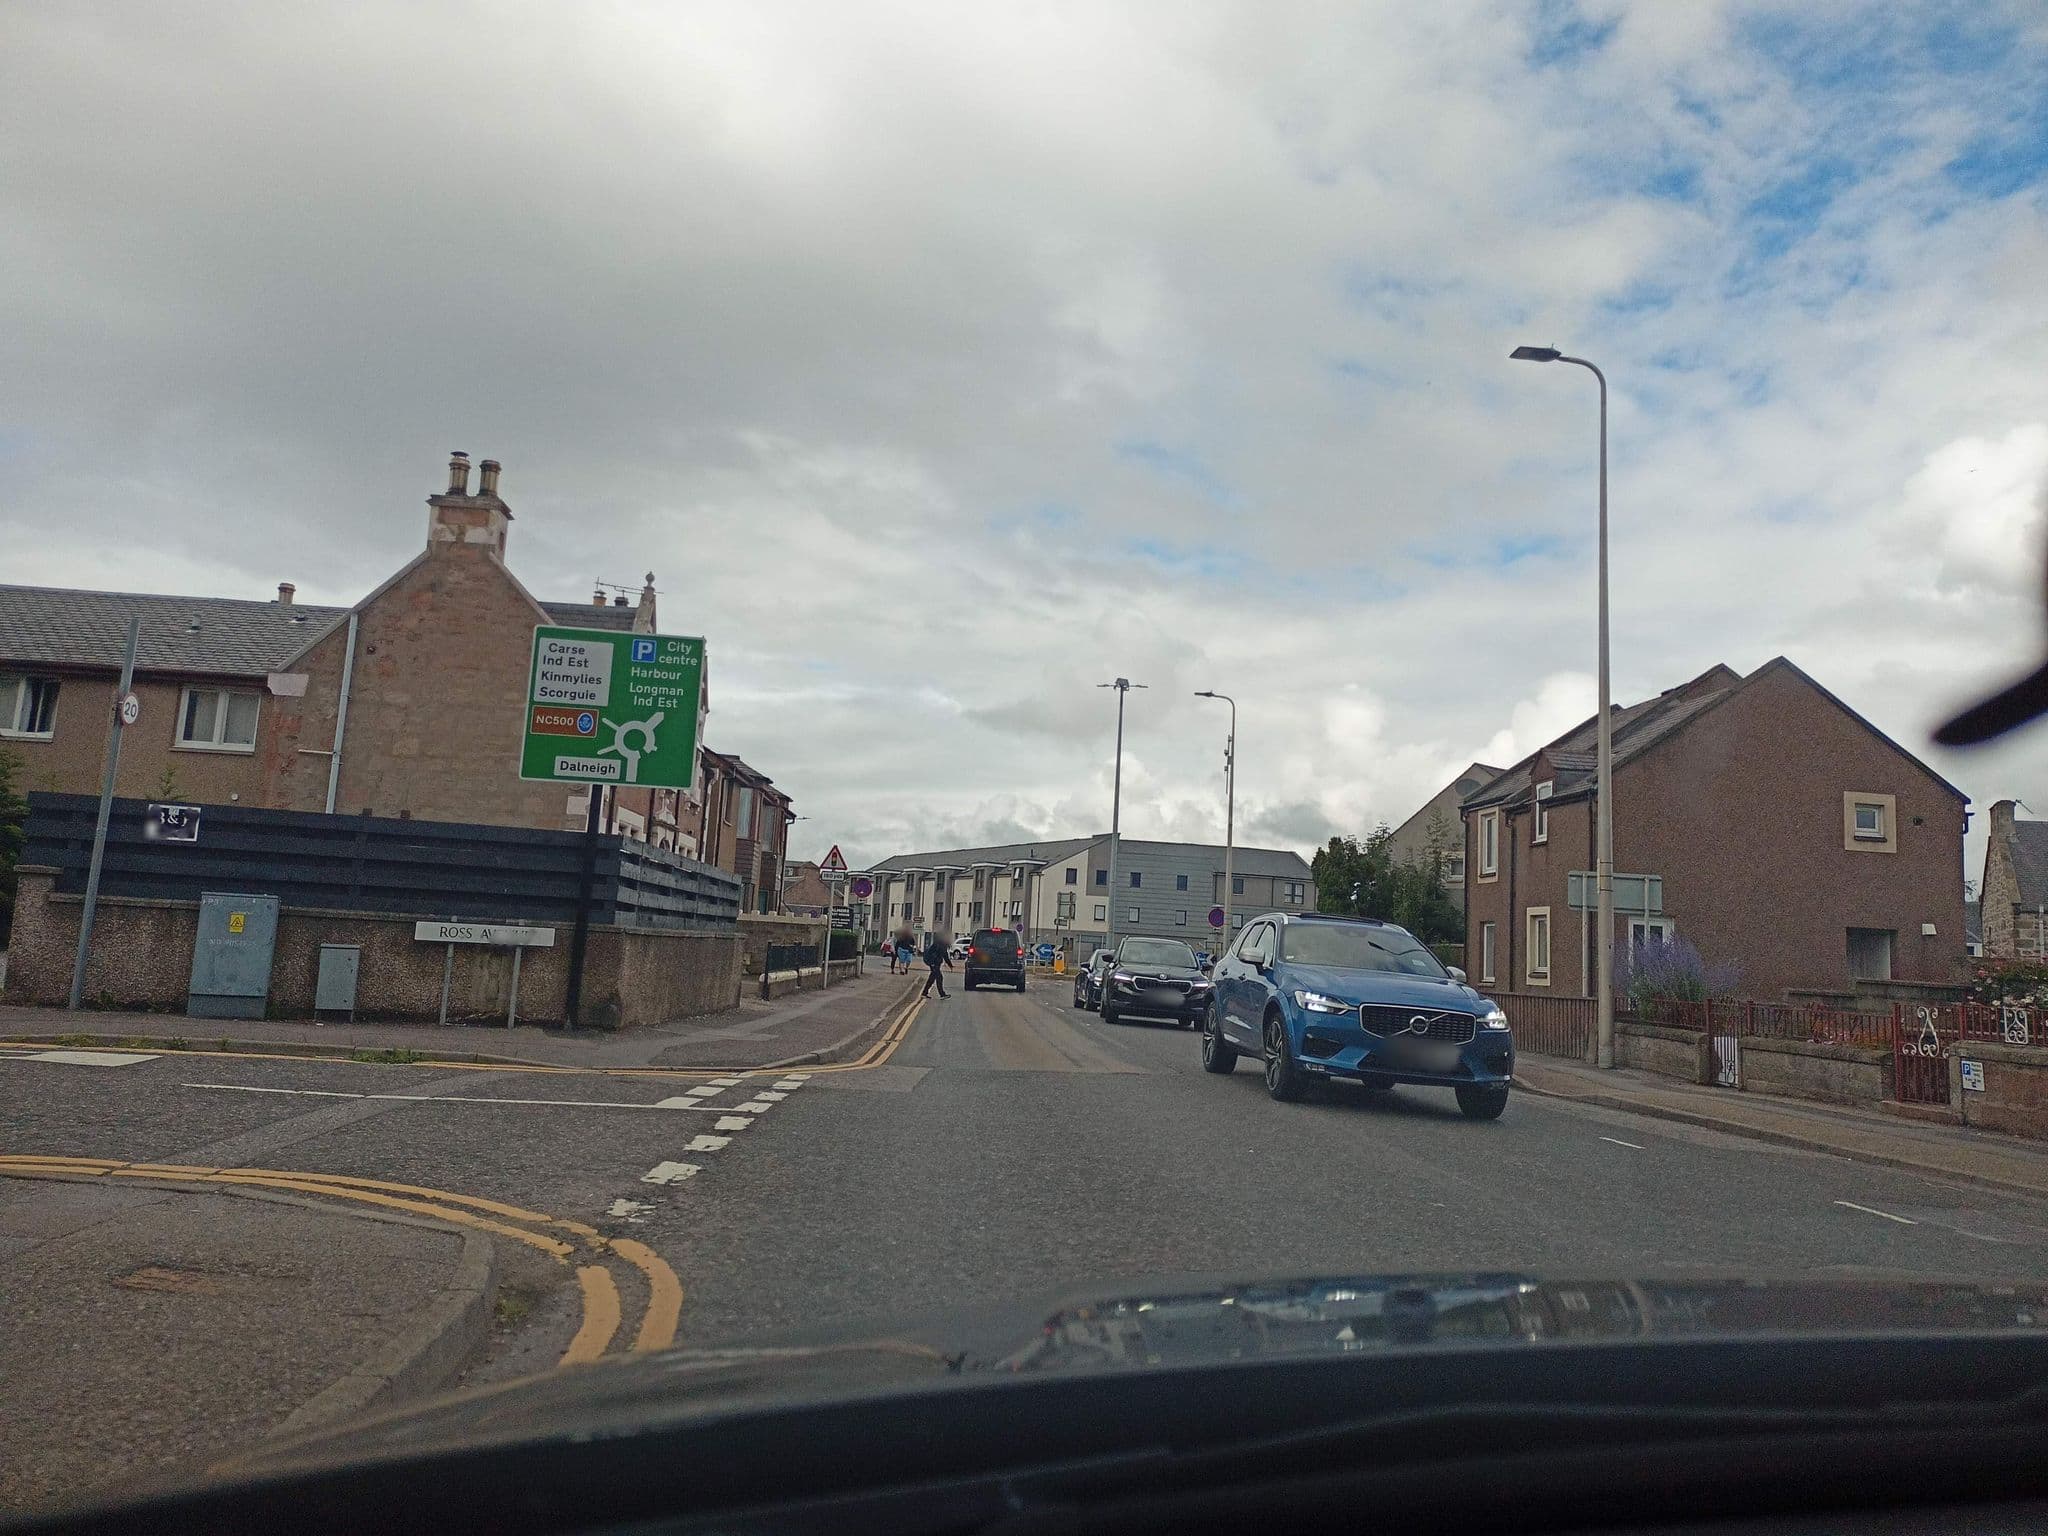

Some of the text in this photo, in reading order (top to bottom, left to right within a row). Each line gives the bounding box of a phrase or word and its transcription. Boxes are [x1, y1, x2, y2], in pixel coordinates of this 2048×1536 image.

[548, 642, 585, 655] Carse
[637, 642, 653, 660] P
[667, 641, 692, 655] City
[543, 655, 589, 668] Ind Est
[658, 655, 698, 666] centre
[541, 670, 602, 685] Kinmylies
[631, 666, 682, 680] Harbour
[539, 686, 596, 701] Scorguie
[629, 682, 684, 696] Longman
[633, 695, 678, 709] Ind Est
[124, 702, 137, 717] 20
[536, 715, 574, 726] NC500
[560, 760, 616, 775] Dalneigh
[439, 926, 473, 939] ROSS
